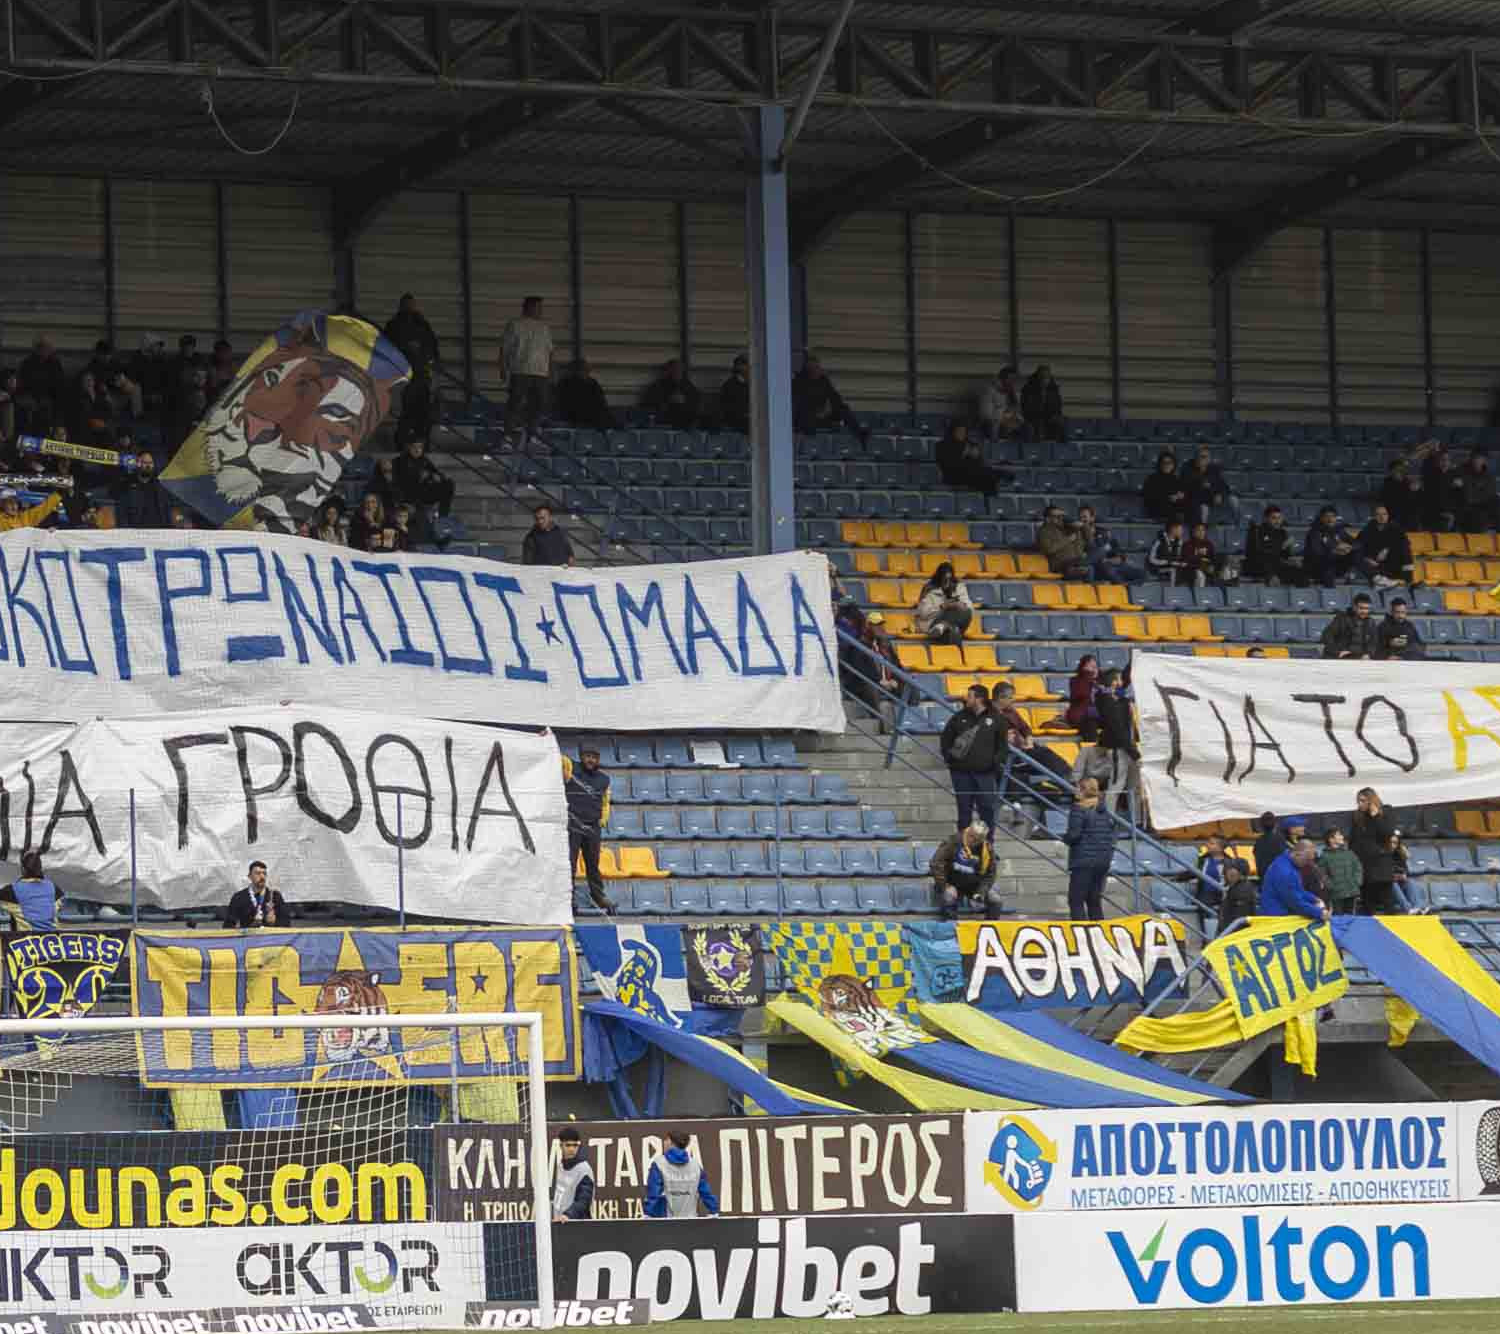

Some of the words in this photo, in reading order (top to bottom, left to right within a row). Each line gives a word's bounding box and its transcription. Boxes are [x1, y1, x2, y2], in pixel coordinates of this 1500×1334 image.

[551, 571, 836, 689] ΟΜΑΔΑ
[1153, 678, 1297, 787] ΓΙΑ
[1291, 693, 1420, 779] ΤΟ
[163, 720, 537, 855] ΓΡΟΘΙΑ
[8, 933, 124, 969] TIGERS
[966, 918, 1187, 1003] ΑΘΗΝΑ
[1225, 920, 1342, 1018] ΑΡΓΟΣ
[718, 1119, 953, 1213] ΠΙΤΕΡΟΣ
[1071, 1116, 1447, 1178] ΑΠΟΣΤΟΛΟΠΟΥΛΟΣ
[1071, 1183, 1175, 1208] ΜΕΤΑΦΟΡΕΣ
[1191, 1180, 1313, 1205] ΜΕΤΑΚΟΜΙΣΕΙΣ
[1328, 1178, 1451, 1201] ΑΠΟΘΗΚΕΥΣΕΙΣ
[576, 1217, 936, 1323] novibet
[1106, 1215, 1431, 1305] volton
